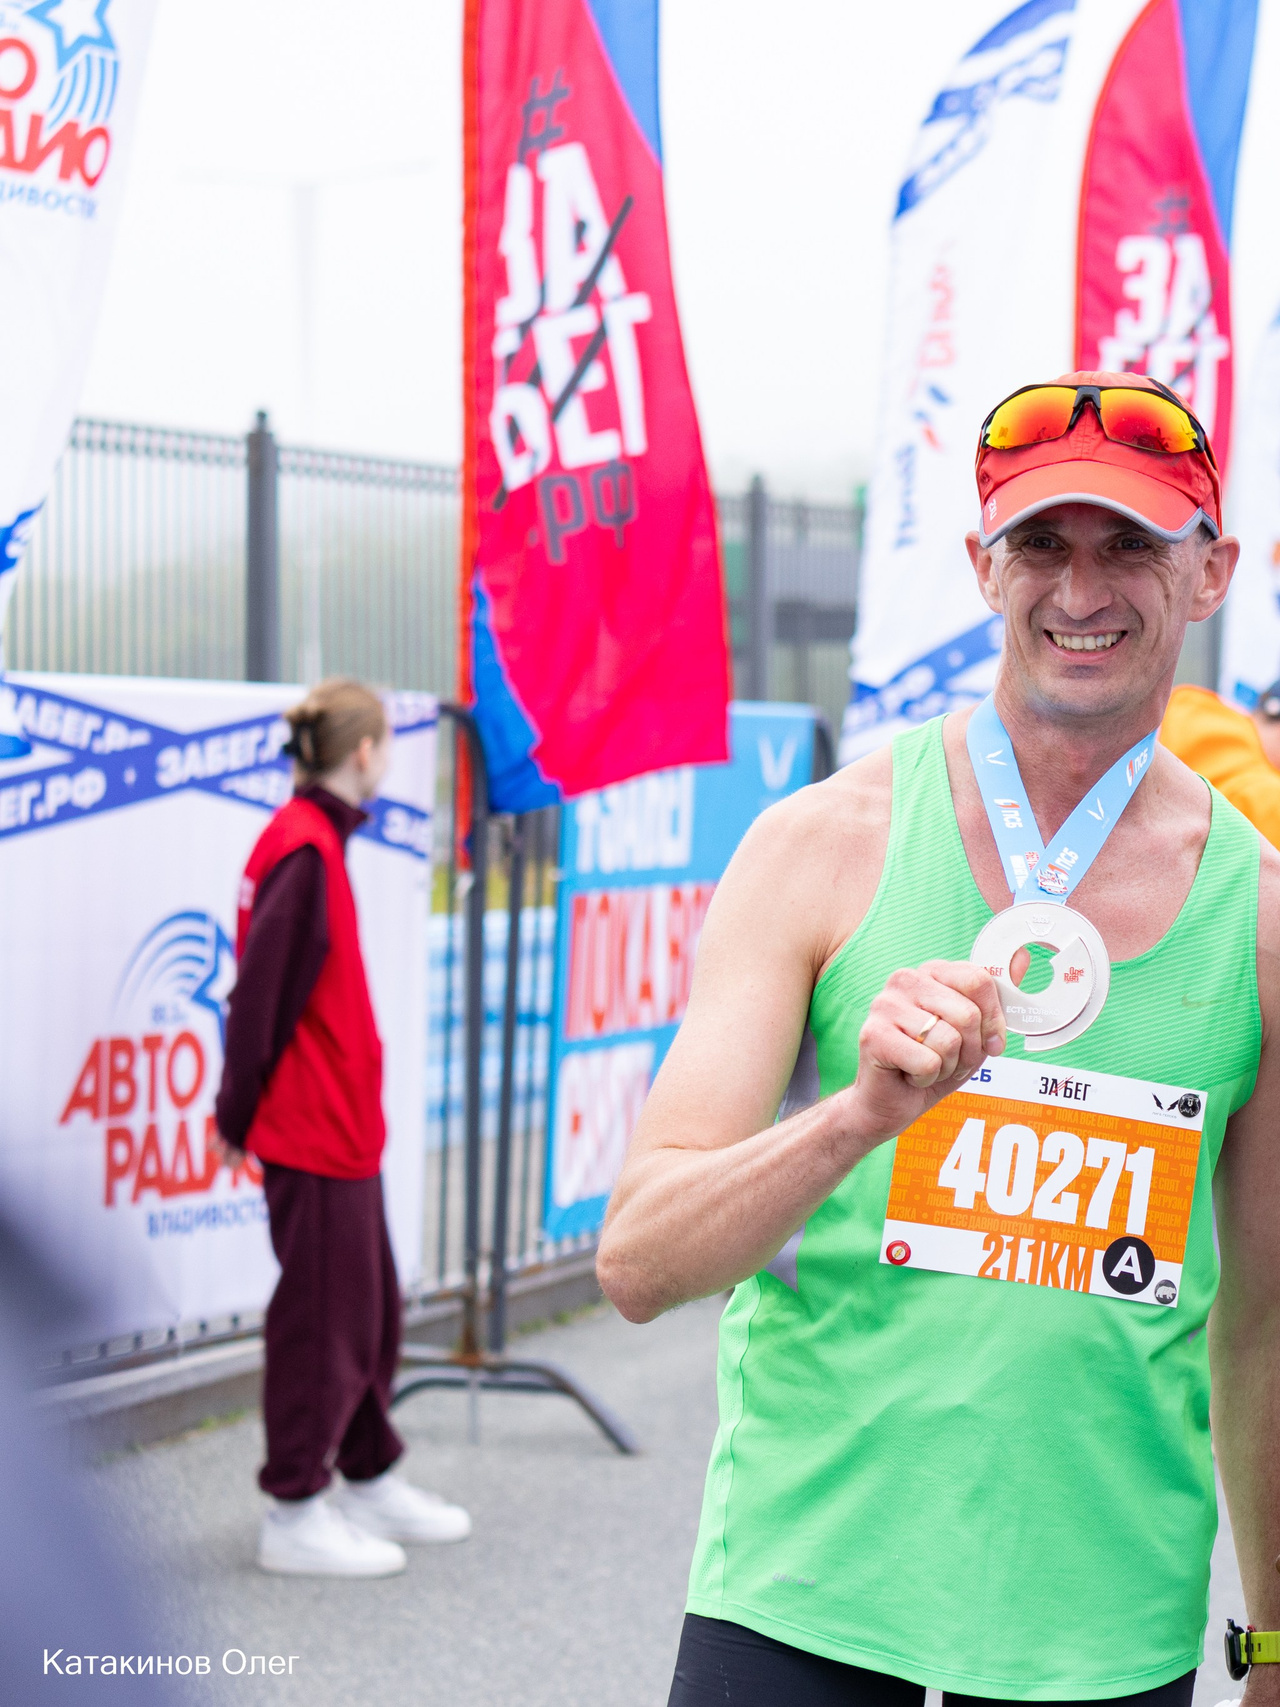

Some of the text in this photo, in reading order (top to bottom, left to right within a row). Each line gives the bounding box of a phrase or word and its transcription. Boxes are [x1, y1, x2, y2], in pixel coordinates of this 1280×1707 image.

[58, 1031, 206, 1126] АВТО
[933, 1209, 1034, 1237] СТРЕСС ДАВНО ОТСТАЛ
[937, 1117, 1155, 1237] 40271
